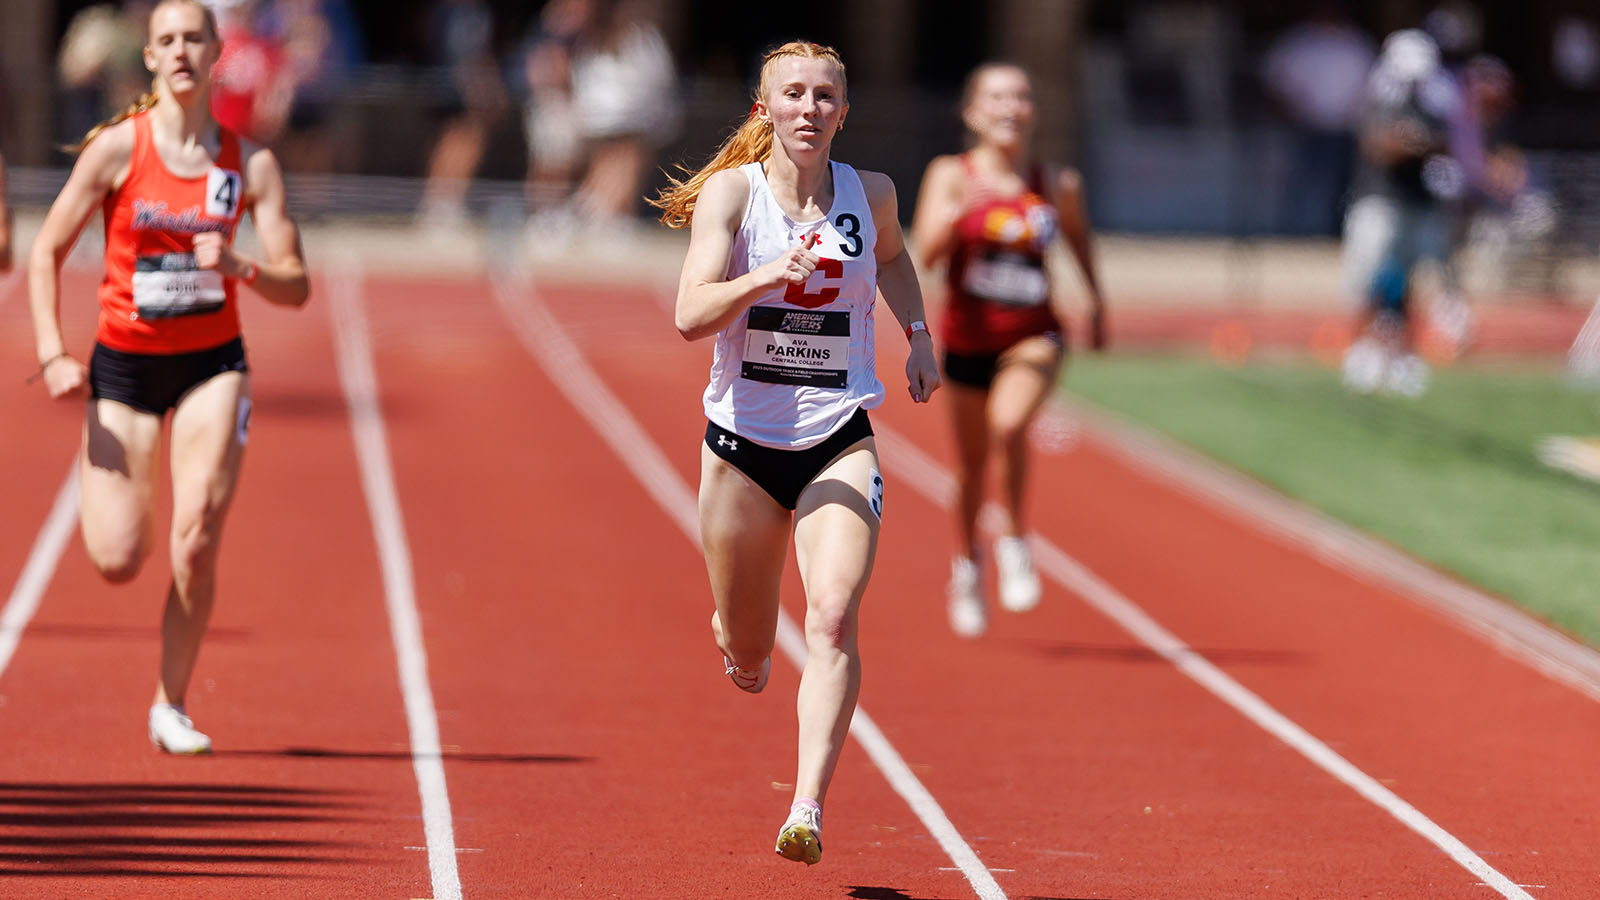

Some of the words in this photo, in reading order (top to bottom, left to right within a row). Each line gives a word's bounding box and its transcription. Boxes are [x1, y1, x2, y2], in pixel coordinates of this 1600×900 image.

[215, 176, 233, 212] 4
[835, 213, 864, 258] 3
[783, 256, 844, 309] C
[783, 312, 826, 322] AMERICAN
[765, 344, 831, 360] PARKINS
[771, 357, 797, 365] CENTRAL
